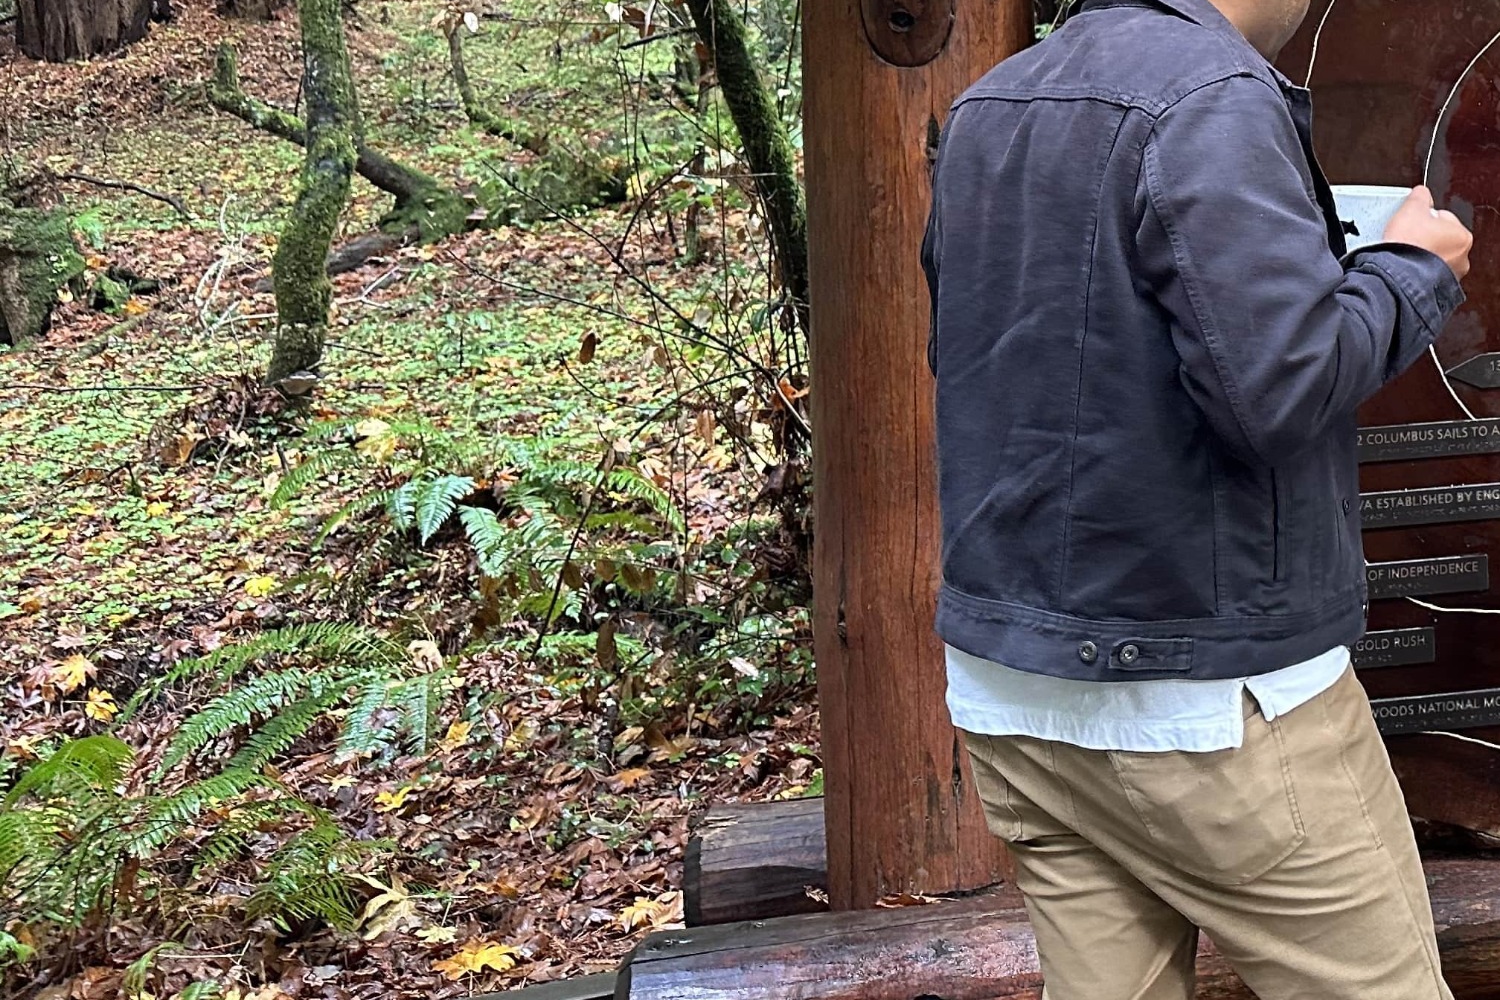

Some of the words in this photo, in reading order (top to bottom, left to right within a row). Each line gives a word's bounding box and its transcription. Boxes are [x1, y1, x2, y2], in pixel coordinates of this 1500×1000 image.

[1366, 430, 1434, 445] COLUMBUS
[1436, 428, 1468, 440] SAILS
[1471, 425, 1488, 438] TO
[1376, 492, 1454, 509] ESTABLISHED
[1456, 490, 1472, 503] BY
[1368, 568, 1385, 581] OF
[1388, 561, 1479, 579] INDEPENDENCE
[1356, 638, 1390, 652] GOLD
[1394, 635, 1426, 648] RUSH
[1418, 697, 1480, 714] NATIONAL
